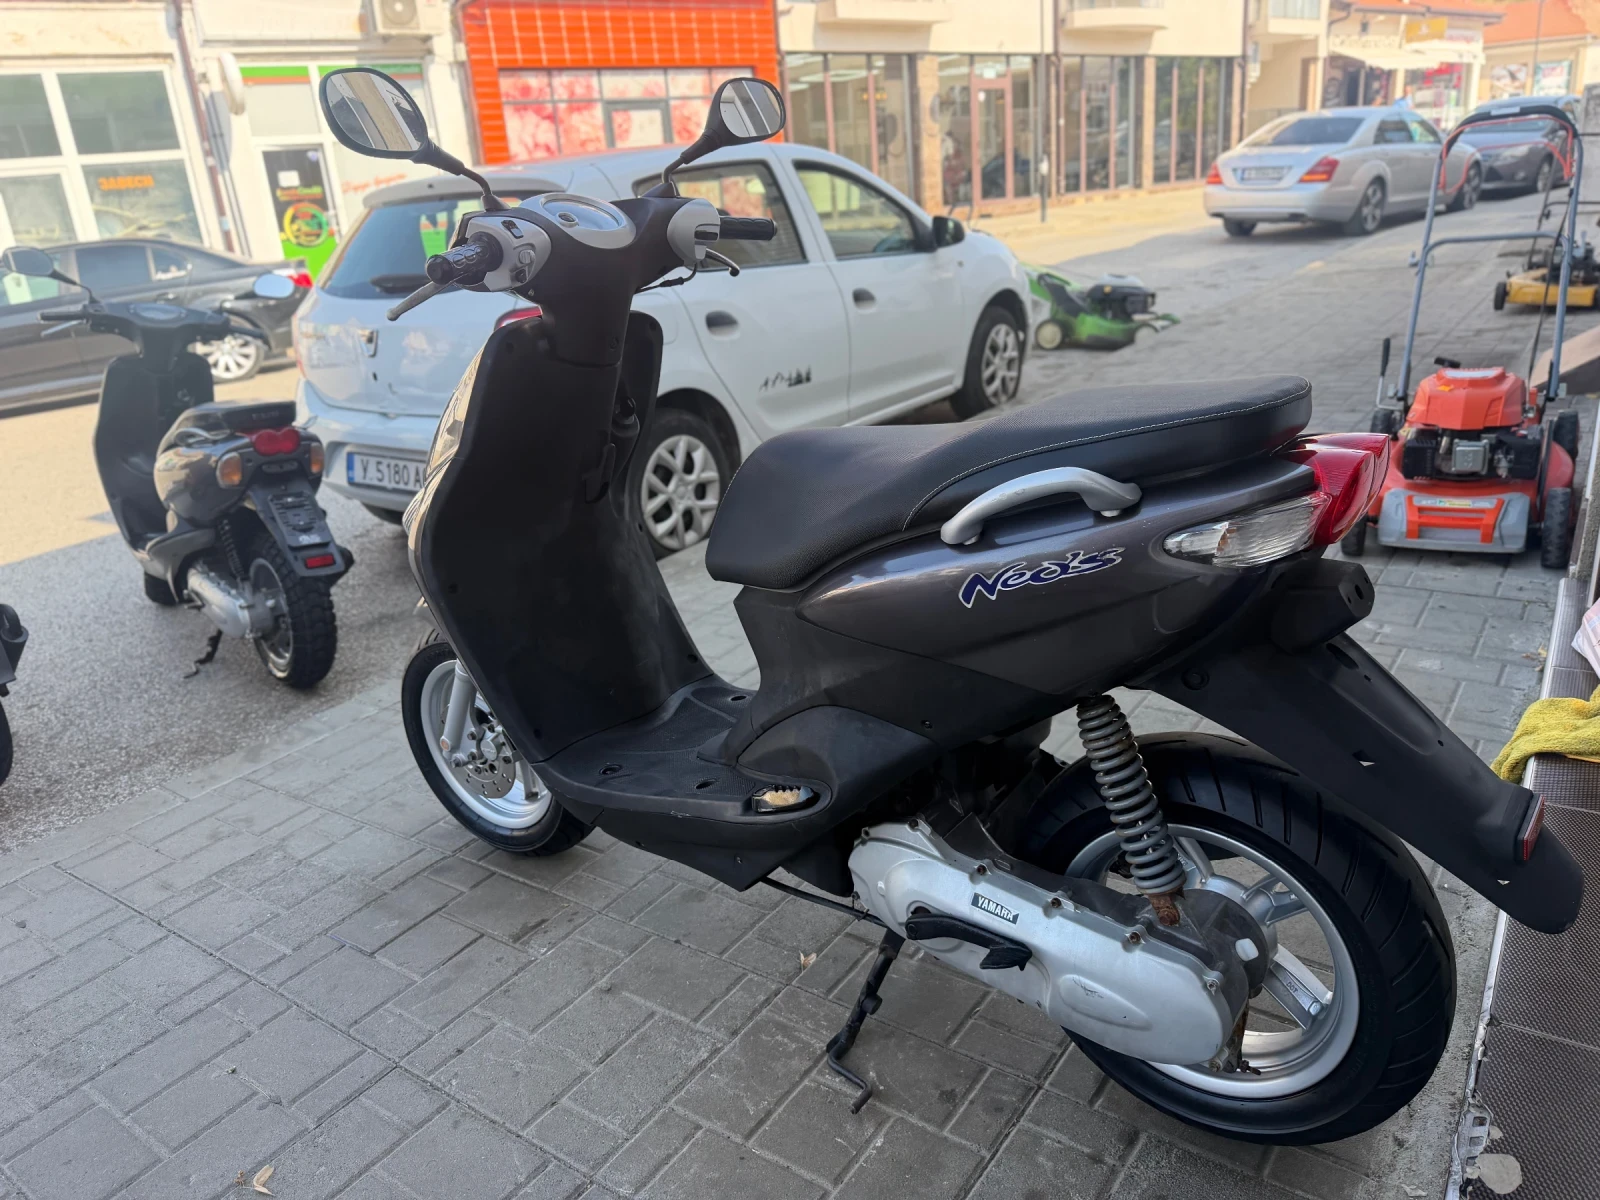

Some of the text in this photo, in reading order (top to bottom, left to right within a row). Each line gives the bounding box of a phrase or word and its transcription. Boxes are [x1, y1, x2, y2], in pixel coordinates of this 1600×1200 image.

[376, 460, 410, 487] 5180
[977, 895, 1014, 922] YAMAHA
[1286, 981, 1299, 994] DOT
